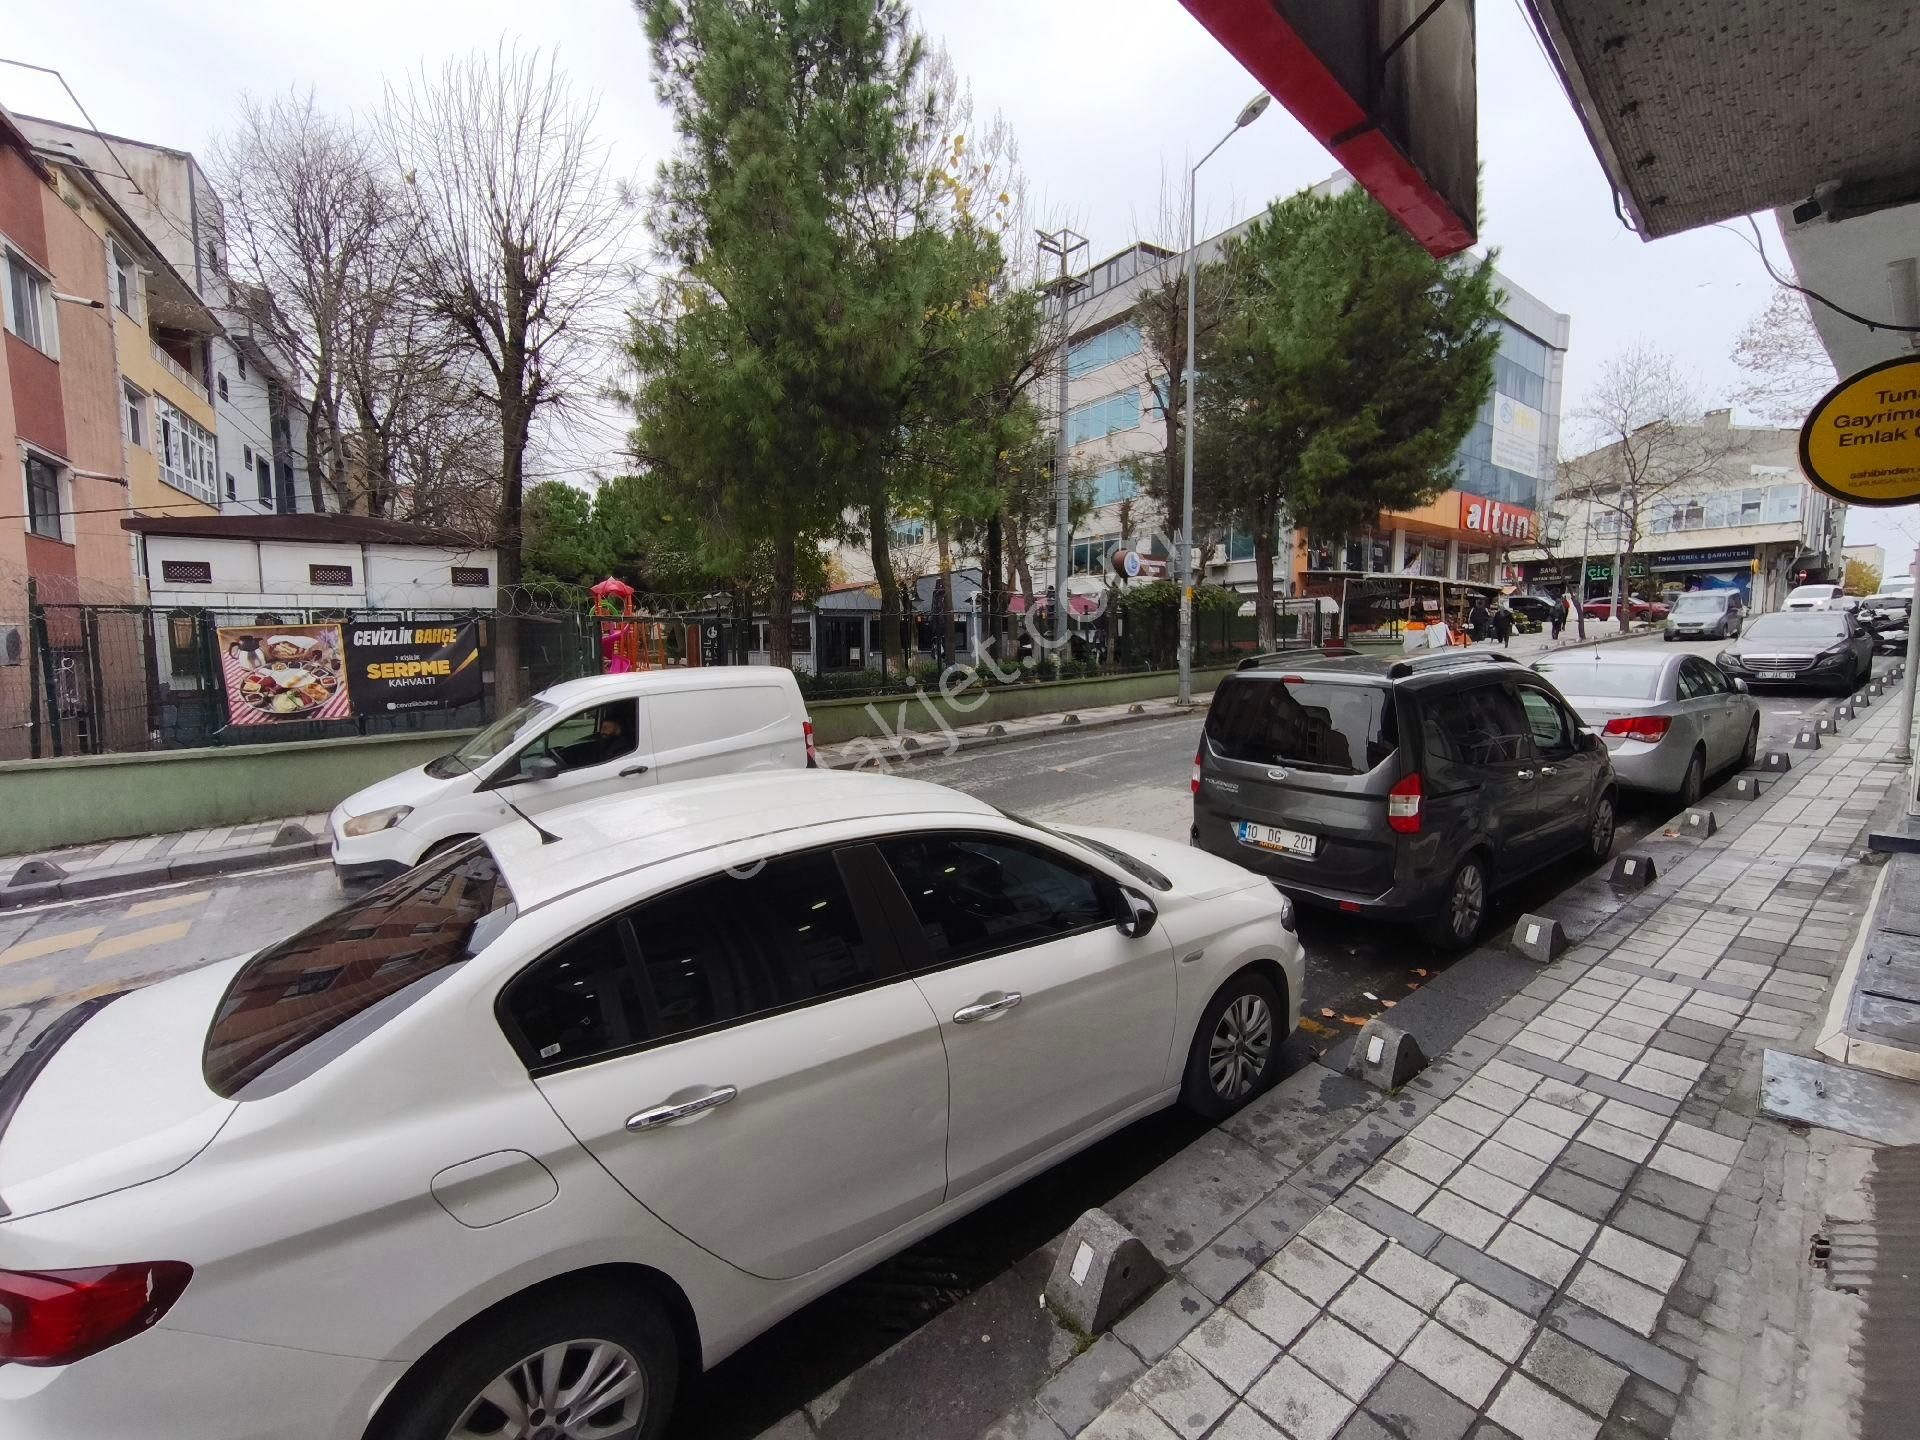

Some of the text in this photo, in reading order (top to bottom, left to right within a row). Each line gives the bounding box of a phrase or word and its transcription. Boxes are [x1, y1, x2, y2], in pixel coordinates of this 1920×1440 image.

[1839, 429, 1907, 447] Emlak
[1466, 499, 1530, 539] altun
[353, 627, 457, 648] CEVİZLİK BAHÇE
[366, 660, 451, 680] SERPME
[388, 677, 436, 688] KAHVALTI
[1247, 824, 1257, 839] 10
[1268, 829, 1281, 844] DG
[1294, 835, 1314, 852] 201
